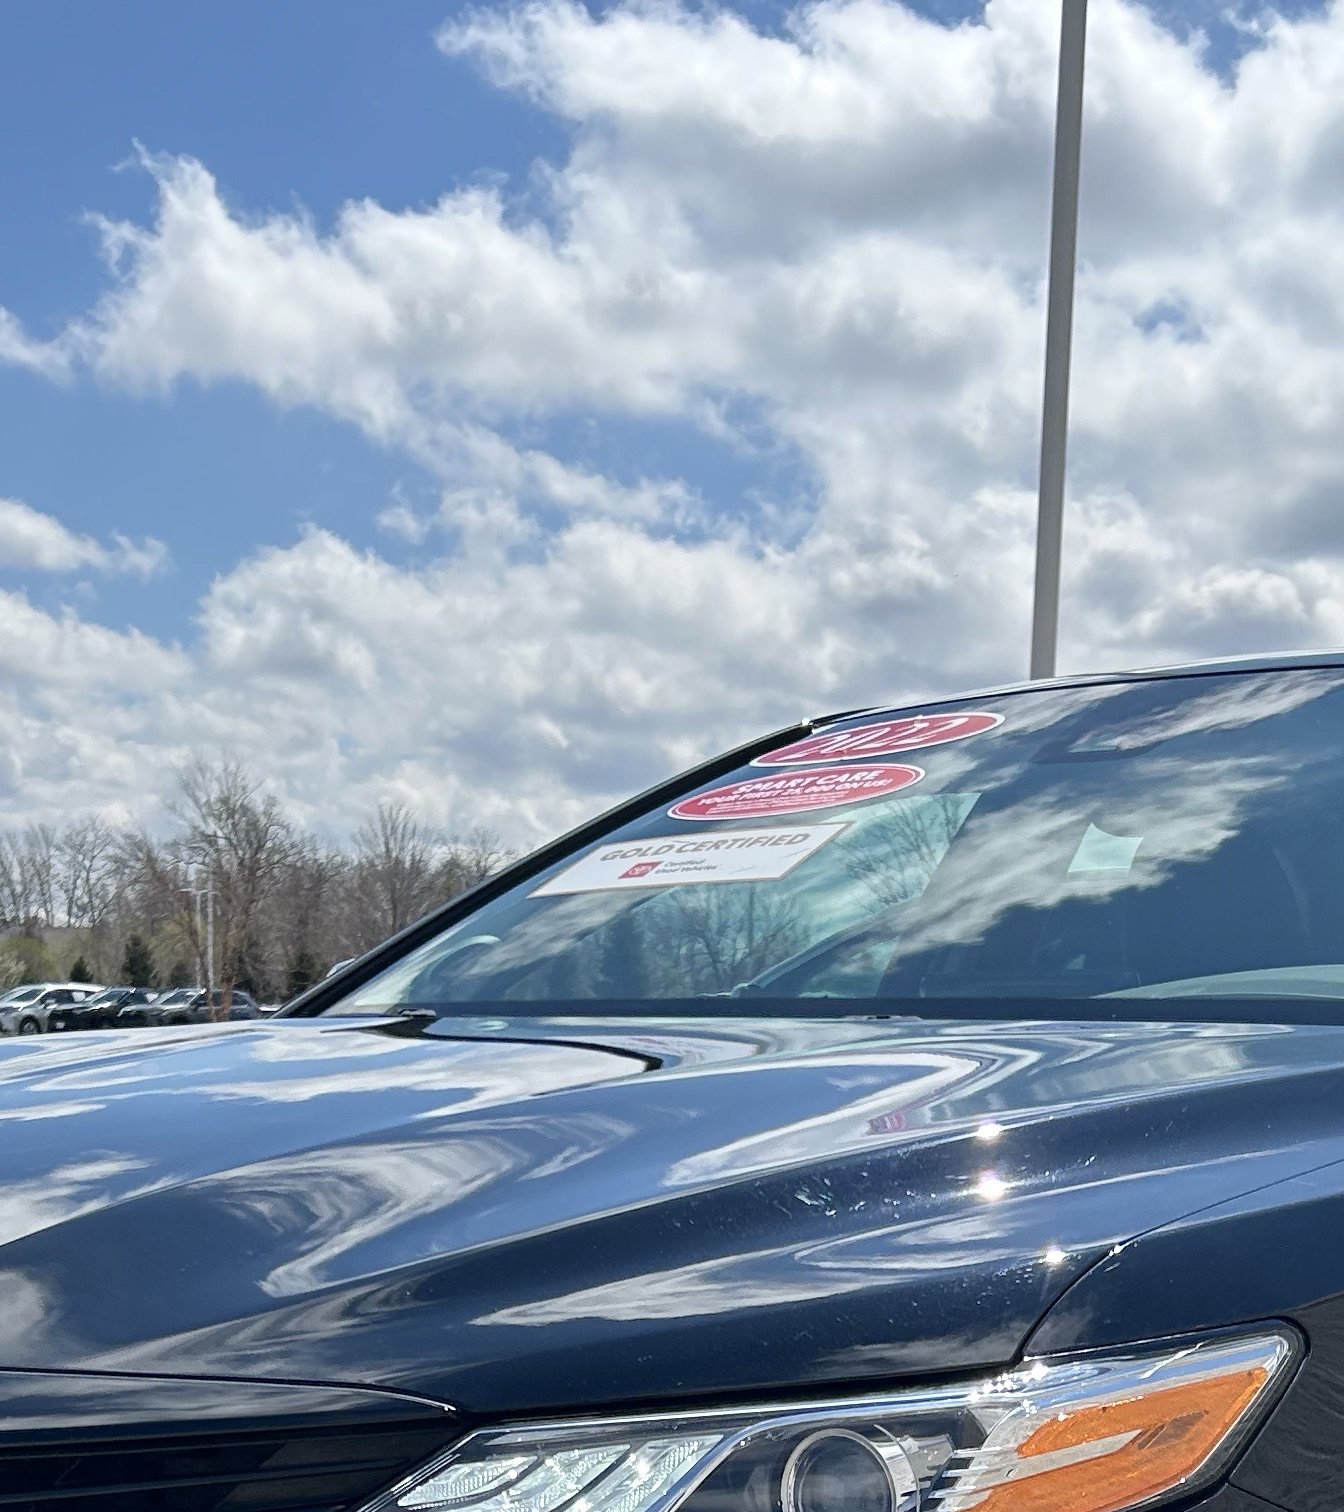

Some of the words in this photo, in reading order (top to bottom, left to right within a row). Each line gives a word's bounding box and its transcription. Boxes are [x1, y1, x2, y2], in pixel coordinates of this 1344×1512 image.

[775, 717, 969, 762] 2022
[732, 776, 820, 795] SMART
[816, 769, 886, 785] CARE
[739, 789, 784, 801] FIRST
[835, 781, 863, 791] ON
[600, 844, 675, 862] GOLD
[676, 833, 811, 853] CERTIFIED
